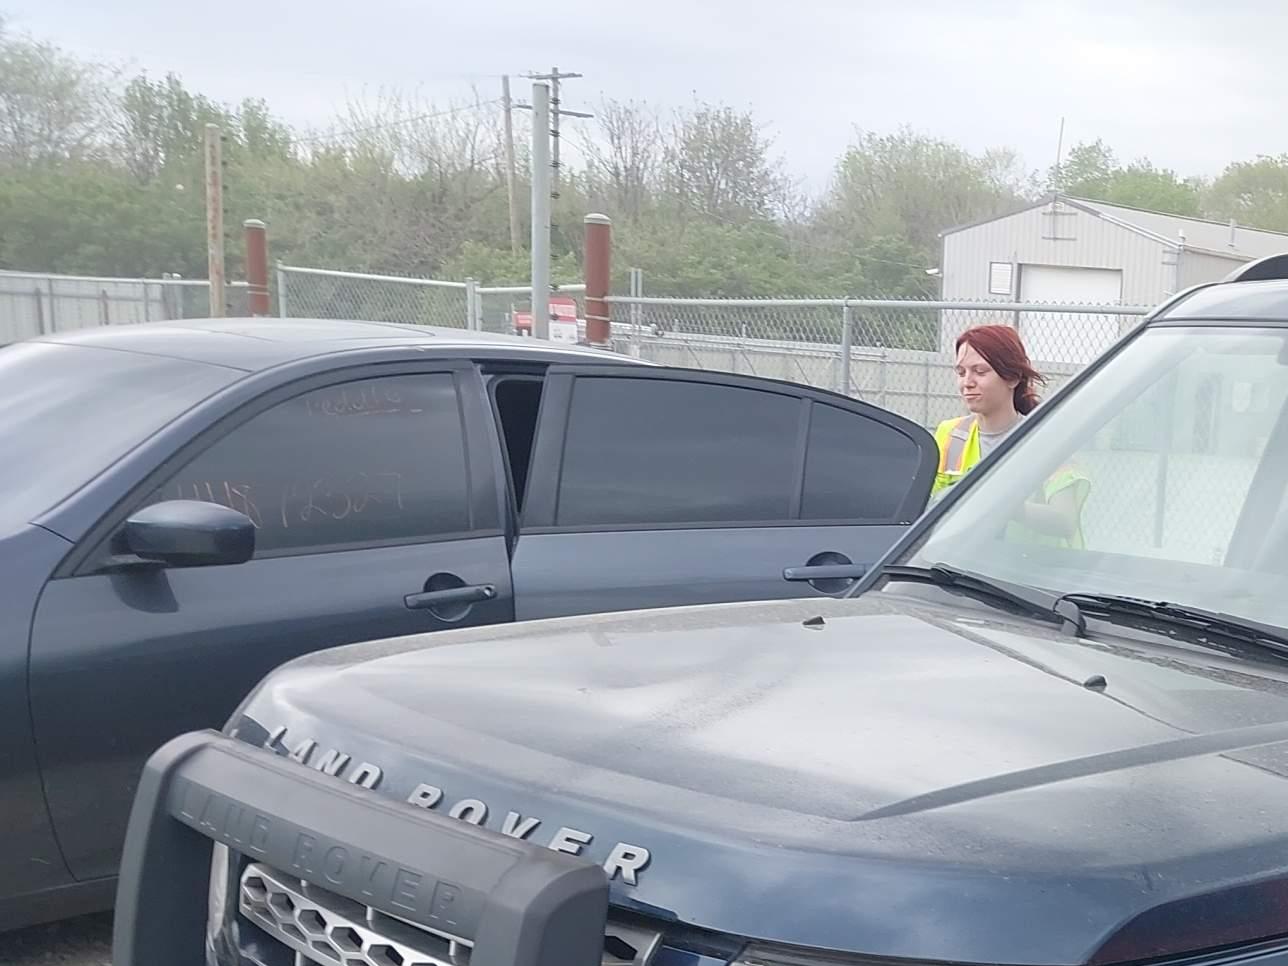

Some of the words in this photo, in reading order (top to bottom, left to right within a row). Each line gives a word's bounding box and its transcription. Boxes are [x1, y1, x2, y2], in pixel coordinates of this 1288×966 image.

[178, 784, 274, 855] LAND
[290, 831, 465, 926] ROVER
[265, 726, 385, 791] LAND
[406, 783, 652, 886] ROVER
